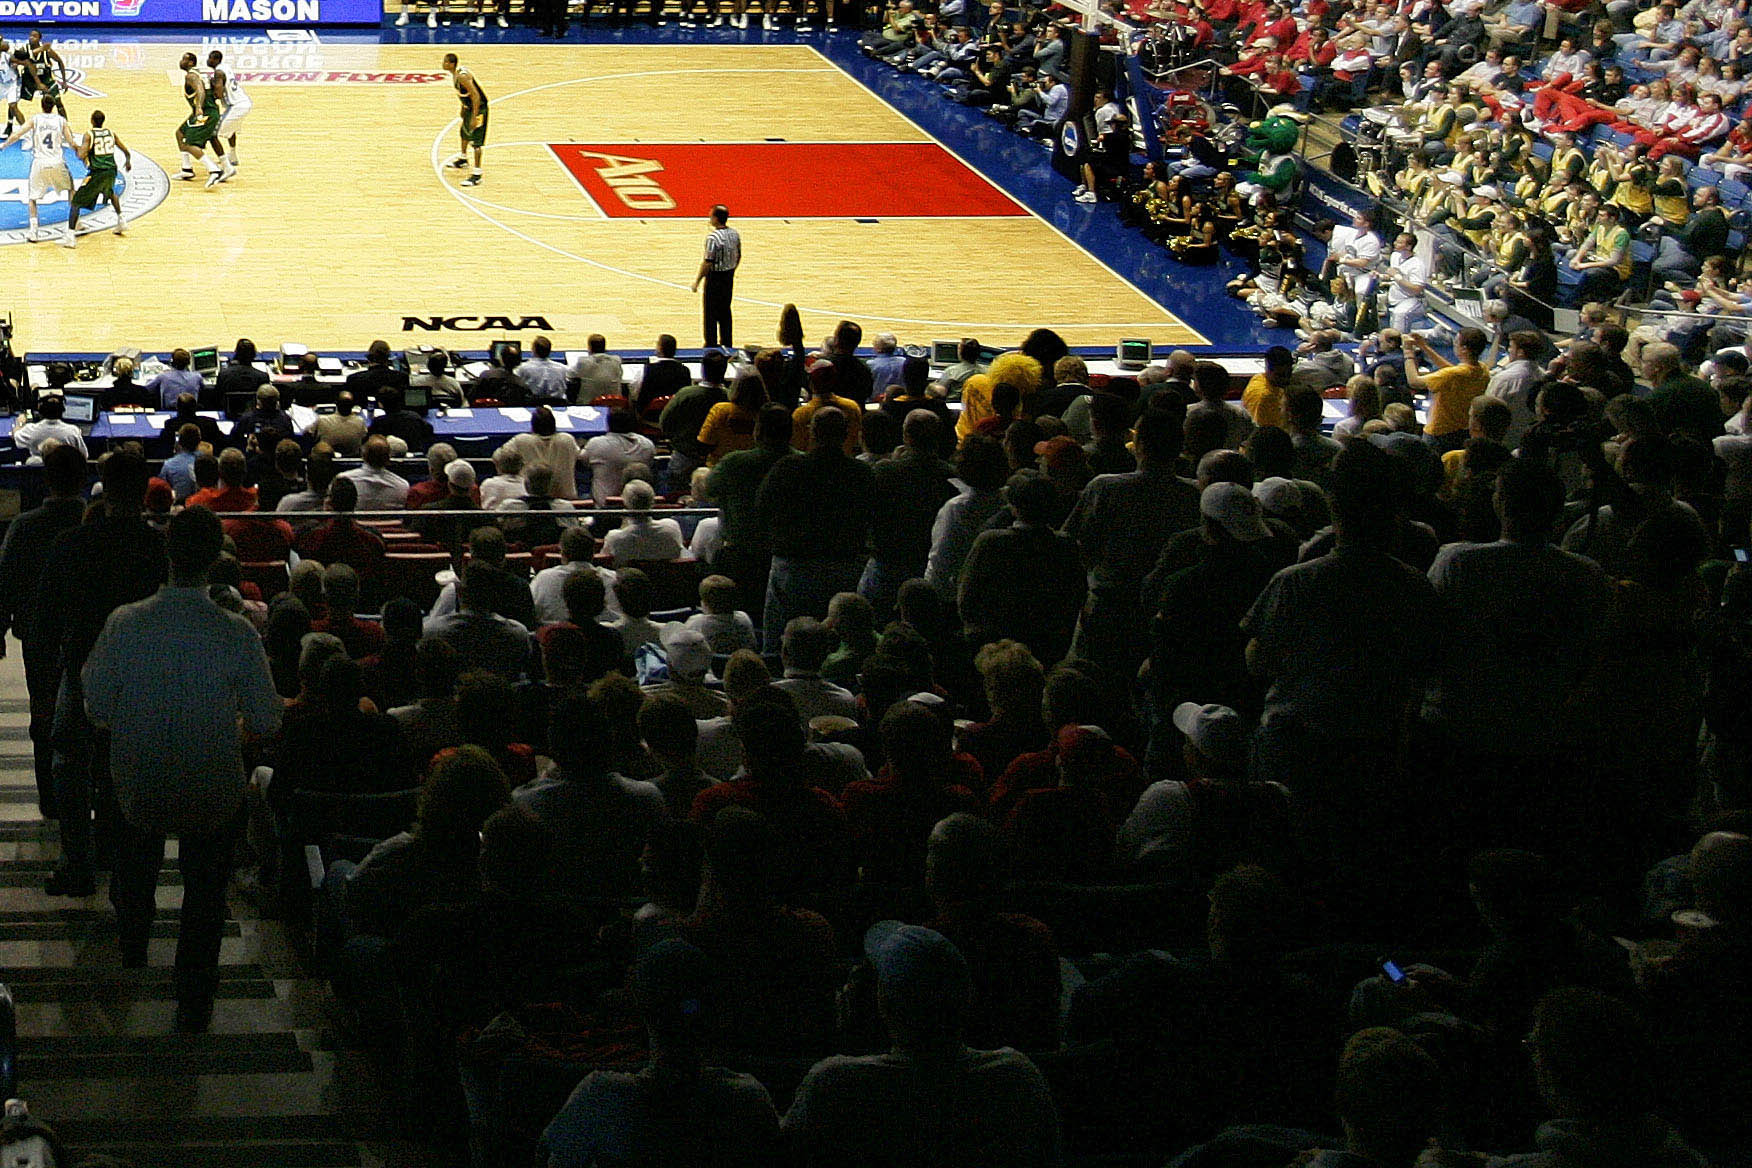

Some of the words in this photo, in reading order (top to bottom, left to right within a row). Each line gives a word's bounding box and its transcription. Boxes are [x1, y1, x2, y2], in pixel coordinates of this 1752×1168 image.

[202, 0, 321, 21] MASON
[324, 72, 446, 84] FLYERS
[43, 132, 54, 150] 4
[93, 137, 115, 156] 22
[577, 149, 678, 210] A10
[401, 316, 556, 332] NCAA
